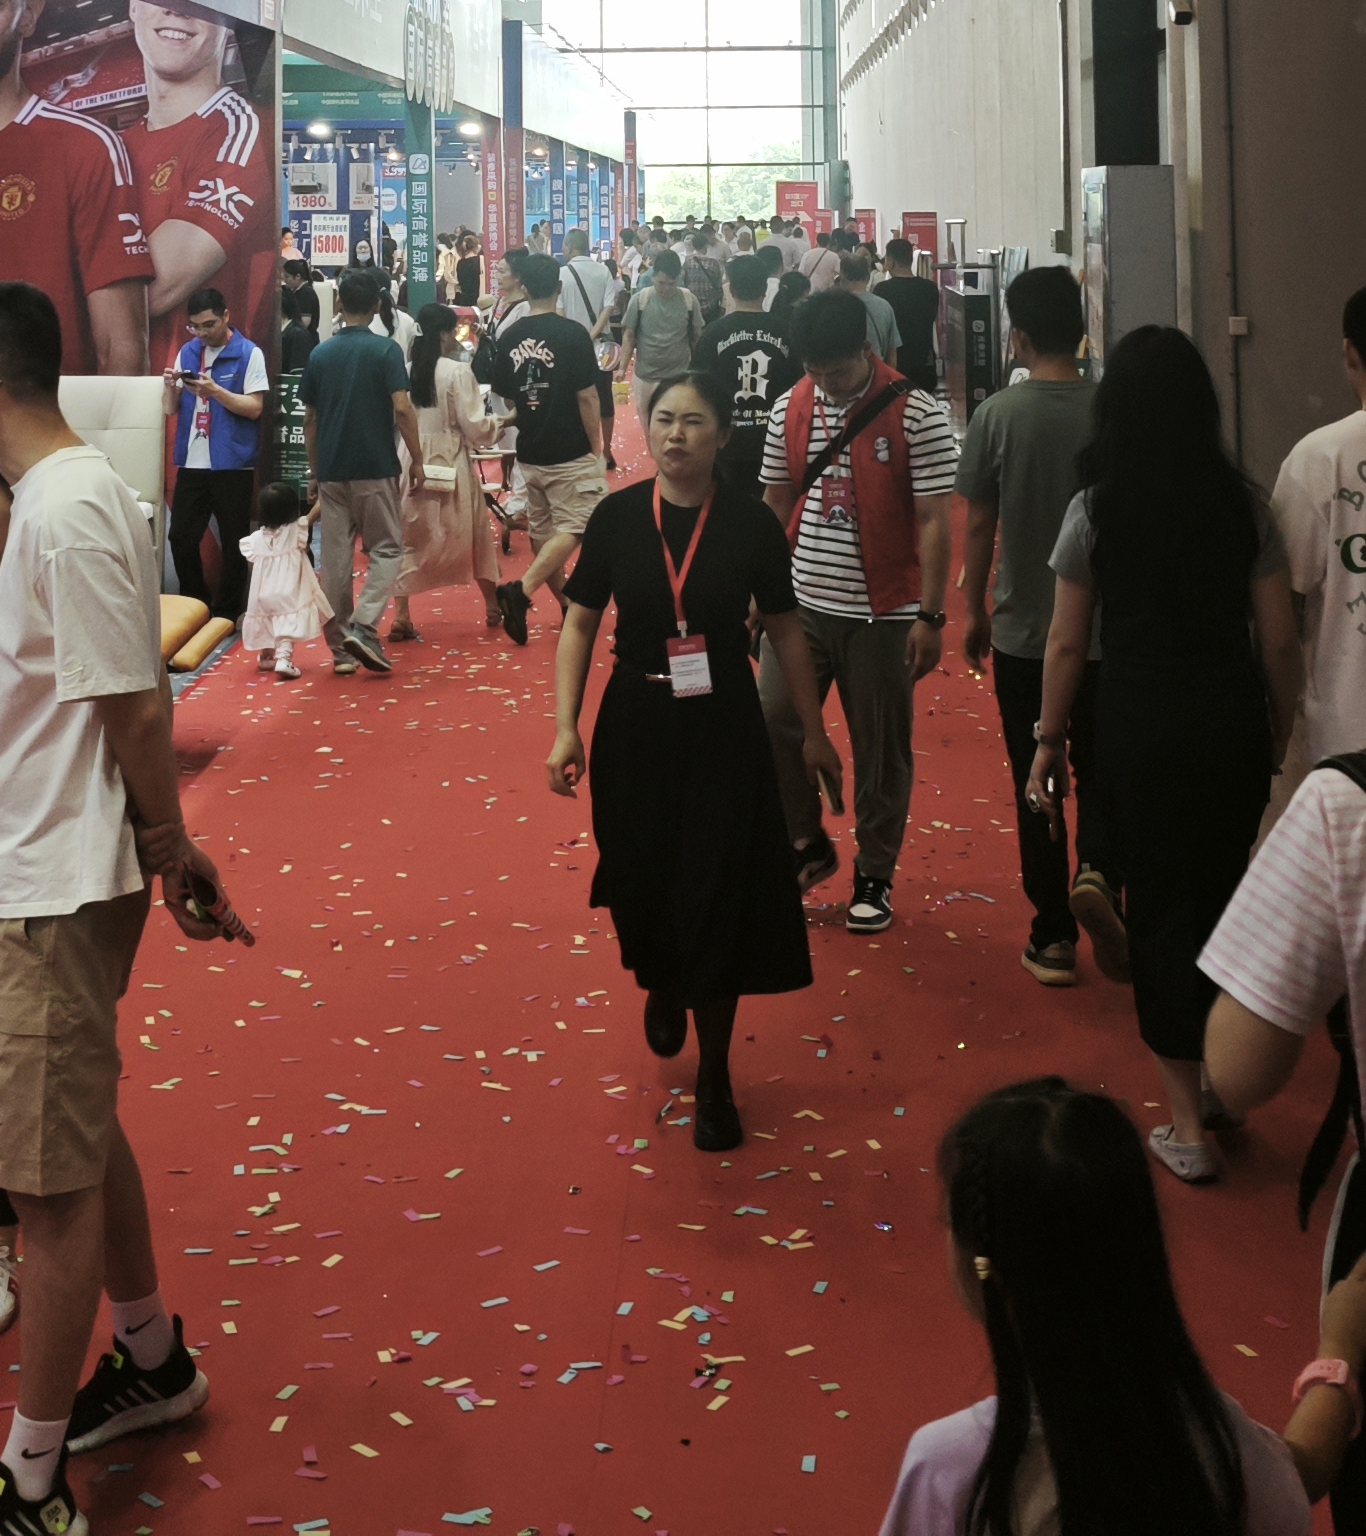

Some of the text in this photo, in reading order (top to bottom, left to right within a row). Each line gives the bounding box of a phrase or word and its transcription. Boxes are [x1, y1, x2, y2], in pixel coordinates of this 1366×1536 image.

[99, 86, 143, 103] STRETFORD
[295, 195, 327, 208] 1980
[411, 181, 429, 283] 国际信誉品牌
[312, 234, 346, 254] 15800
